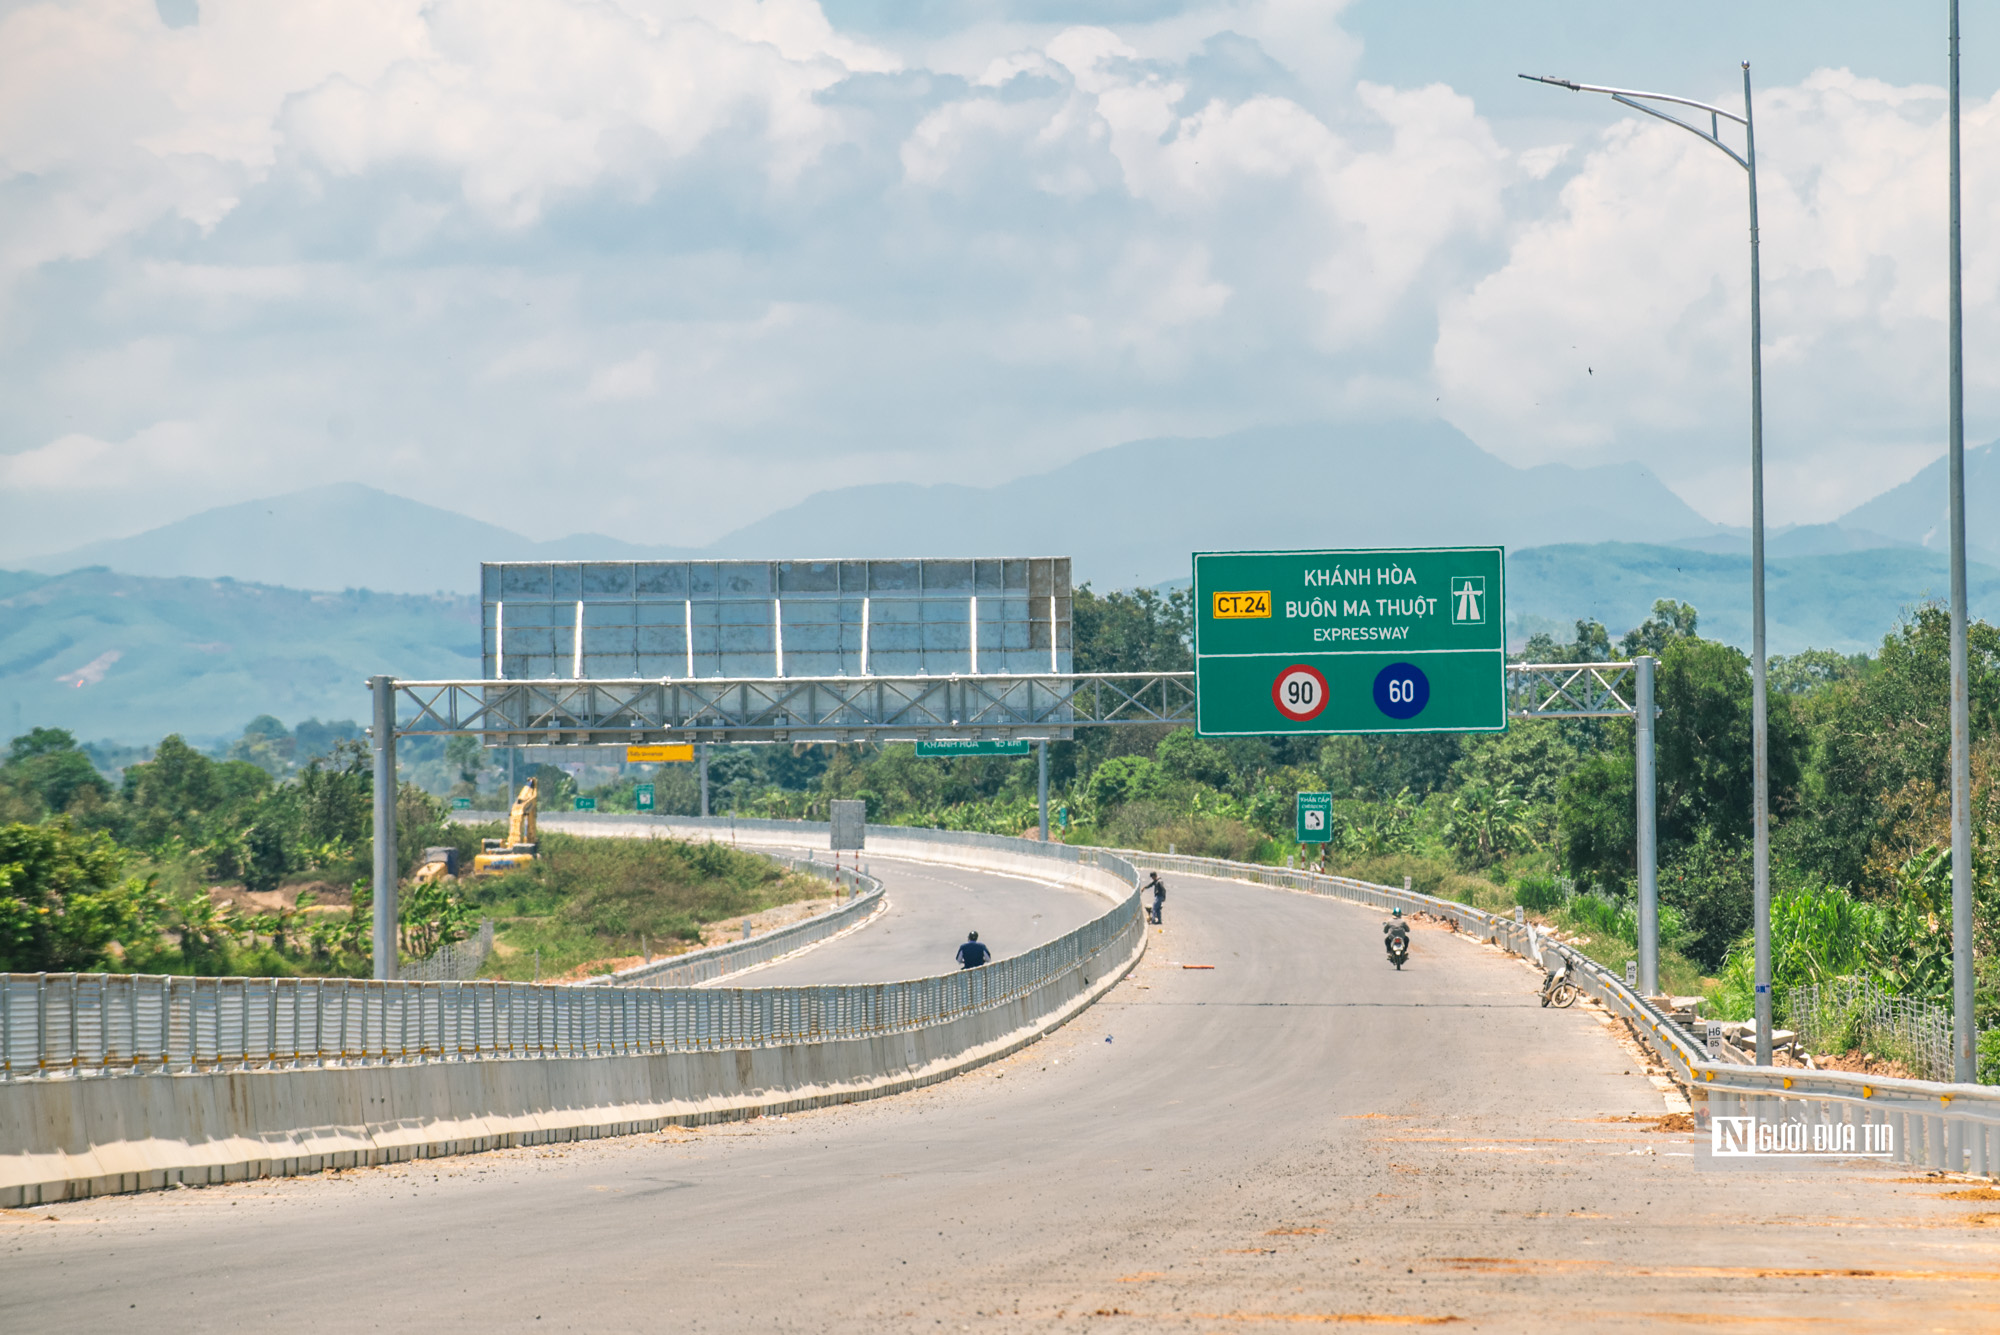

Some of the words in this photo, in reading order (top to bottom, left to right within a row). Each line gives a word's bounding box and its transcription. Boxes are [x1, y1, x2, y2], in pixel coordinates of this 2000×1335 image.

[1304, 564, 1371, 586] KHÁNH
[1377, 562, 1417, 585] HÒA
[1217, 596, 1267, 613] CT.24
[1285, 597, 1337, 618] BUÔN
[1343, 600, 1371, 616] MA
[1376, 595, 1437, 619] THUỘT
[1313, 627, 1409, 641] EXPRESSWAY
[1288, 681, 1313, 704] 90
[1389, 679, 1414, 703] 60
[1708, 1027, 1720, 1036] H6
